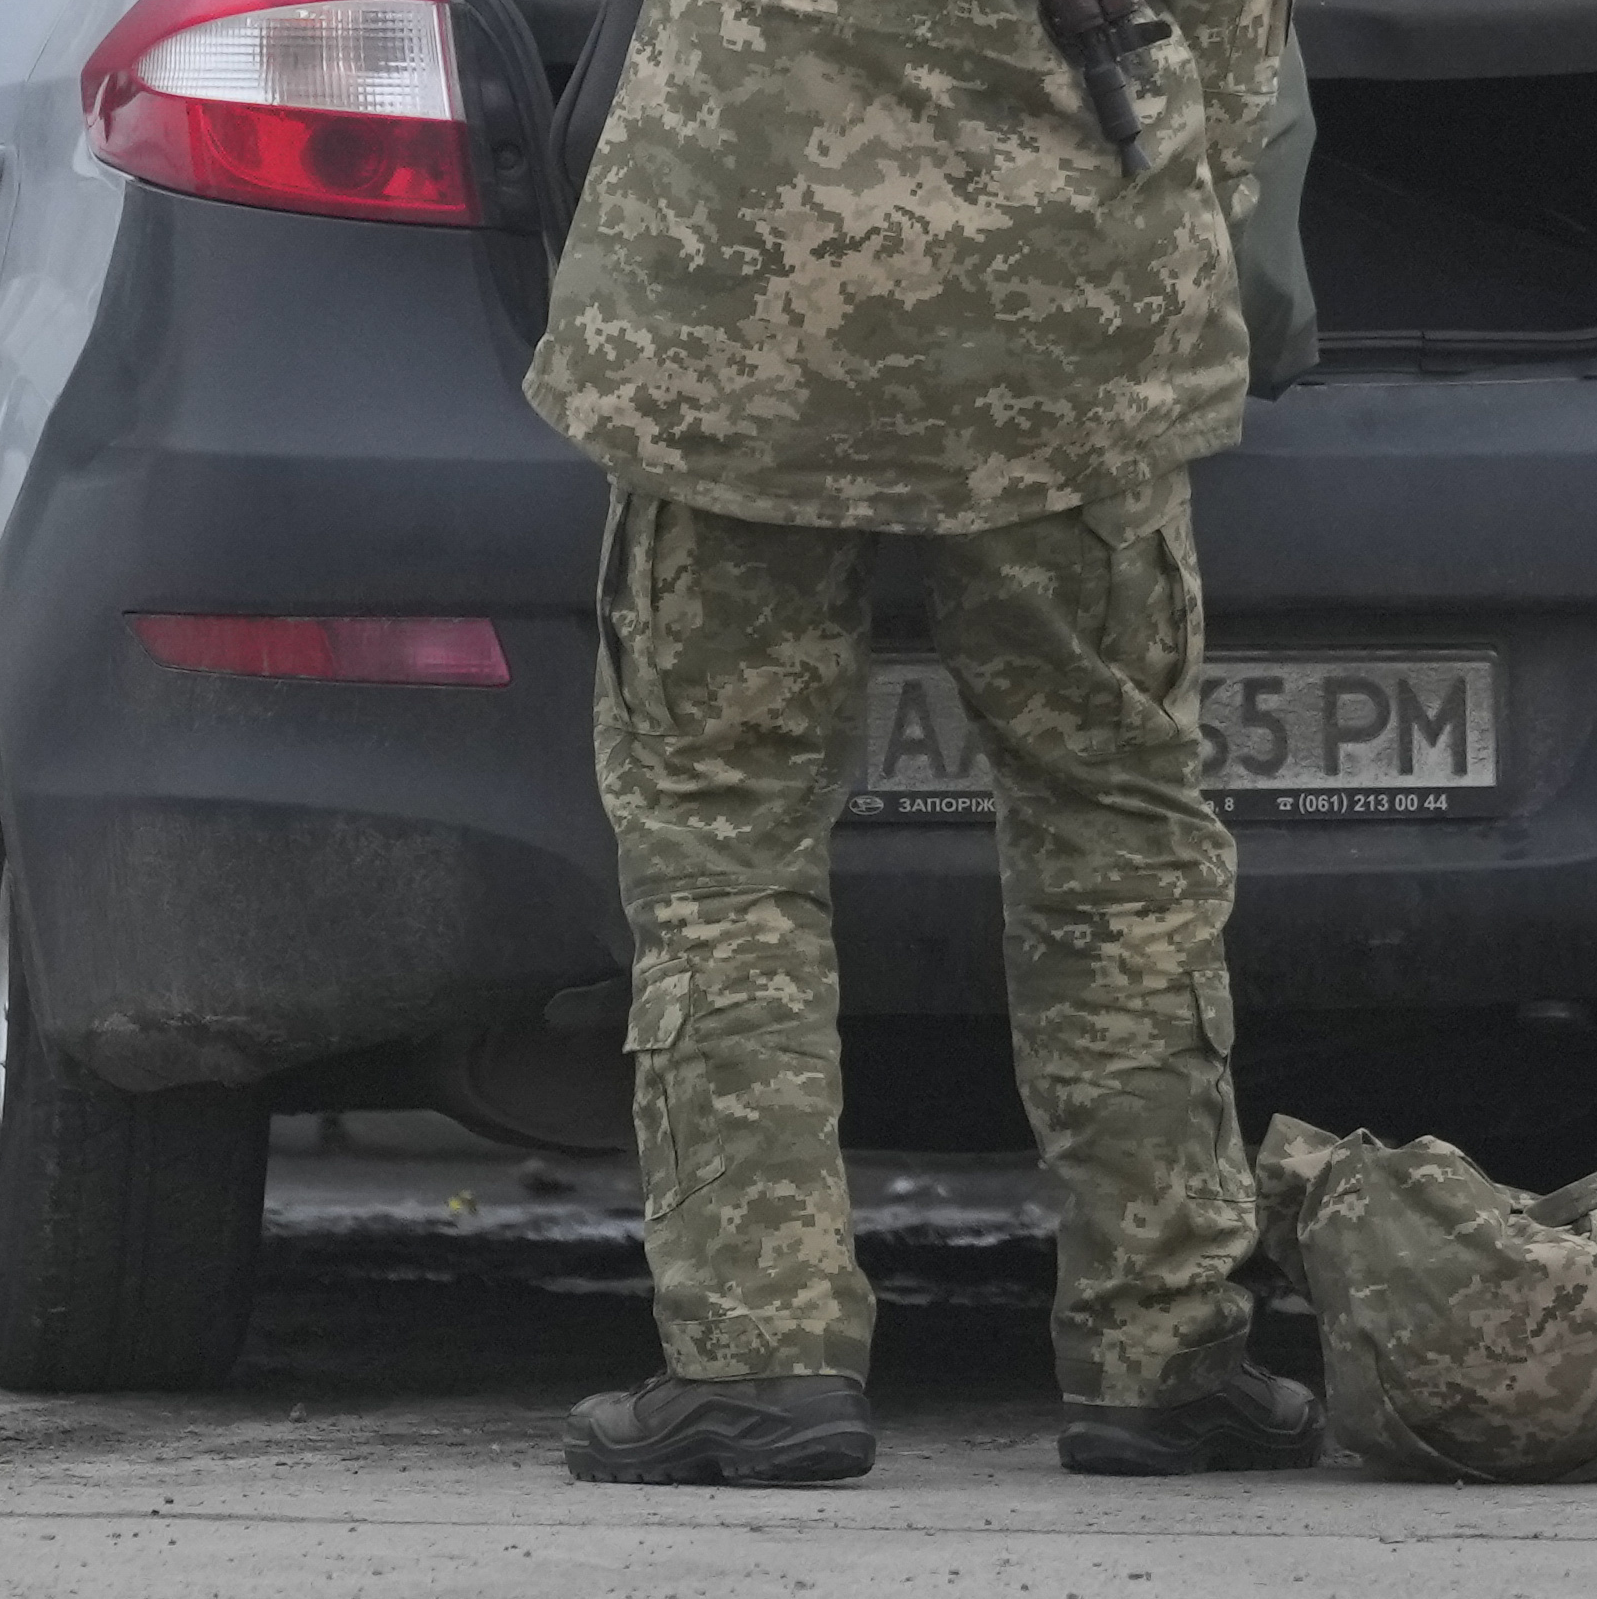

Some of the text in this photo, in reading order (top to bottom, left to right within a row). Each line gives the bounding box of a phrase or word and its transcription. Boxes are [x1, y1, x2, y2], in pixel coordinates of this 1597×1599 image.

[882, 677, 984, 780] A
[1298, 792, 1348, 814] (061)
[1353, 794, 1389, 812] 213
[1395, 794, 1418, 812] 00
[1423, 793, 1449, 812] 44
